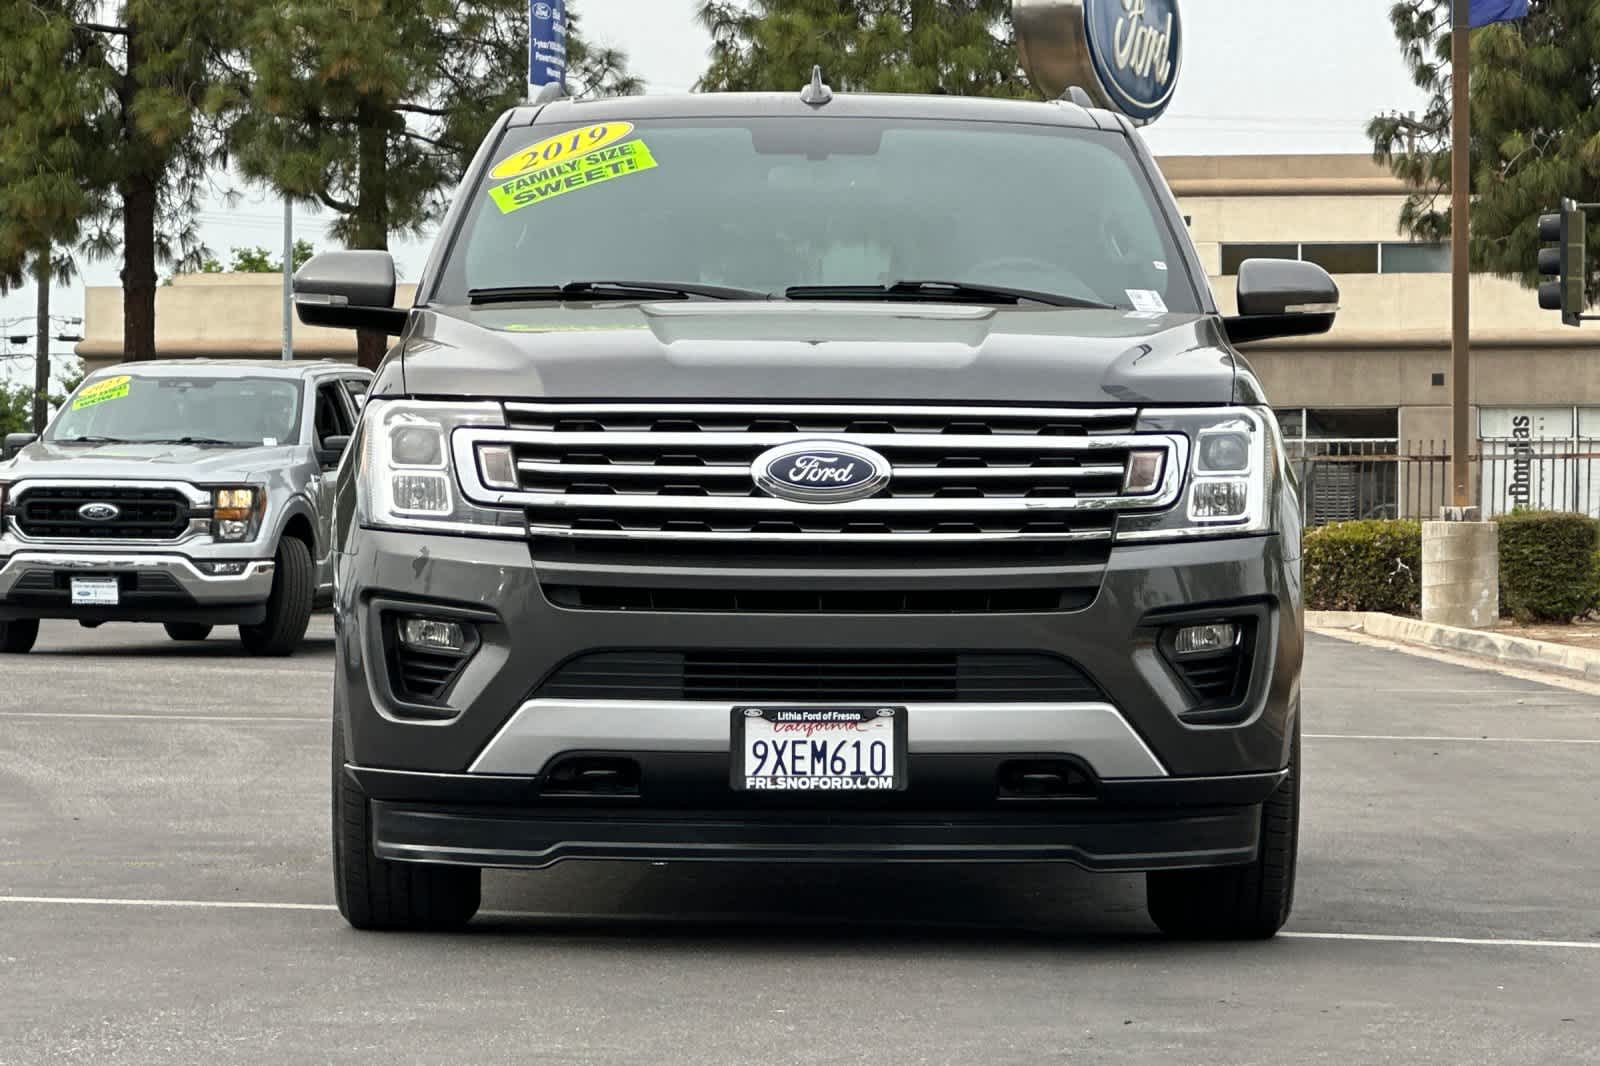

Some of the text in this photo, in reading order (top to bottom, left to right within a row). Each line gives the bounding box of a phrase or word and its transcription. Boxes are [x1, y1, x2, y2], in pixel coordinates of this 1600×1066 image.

[1113, 0, 1173, 87] Ford
[503, 144, 637, 195] FAMILY SIZE
[520, 126, 608, 171] 2019
[513, 157, 636, 206] SWEET!
[789, 455, 855, 481] Ford
[777, 711, 861, 720] Lithia Ford of Fresno
[752, 739, 887, 776] 9XEM610
